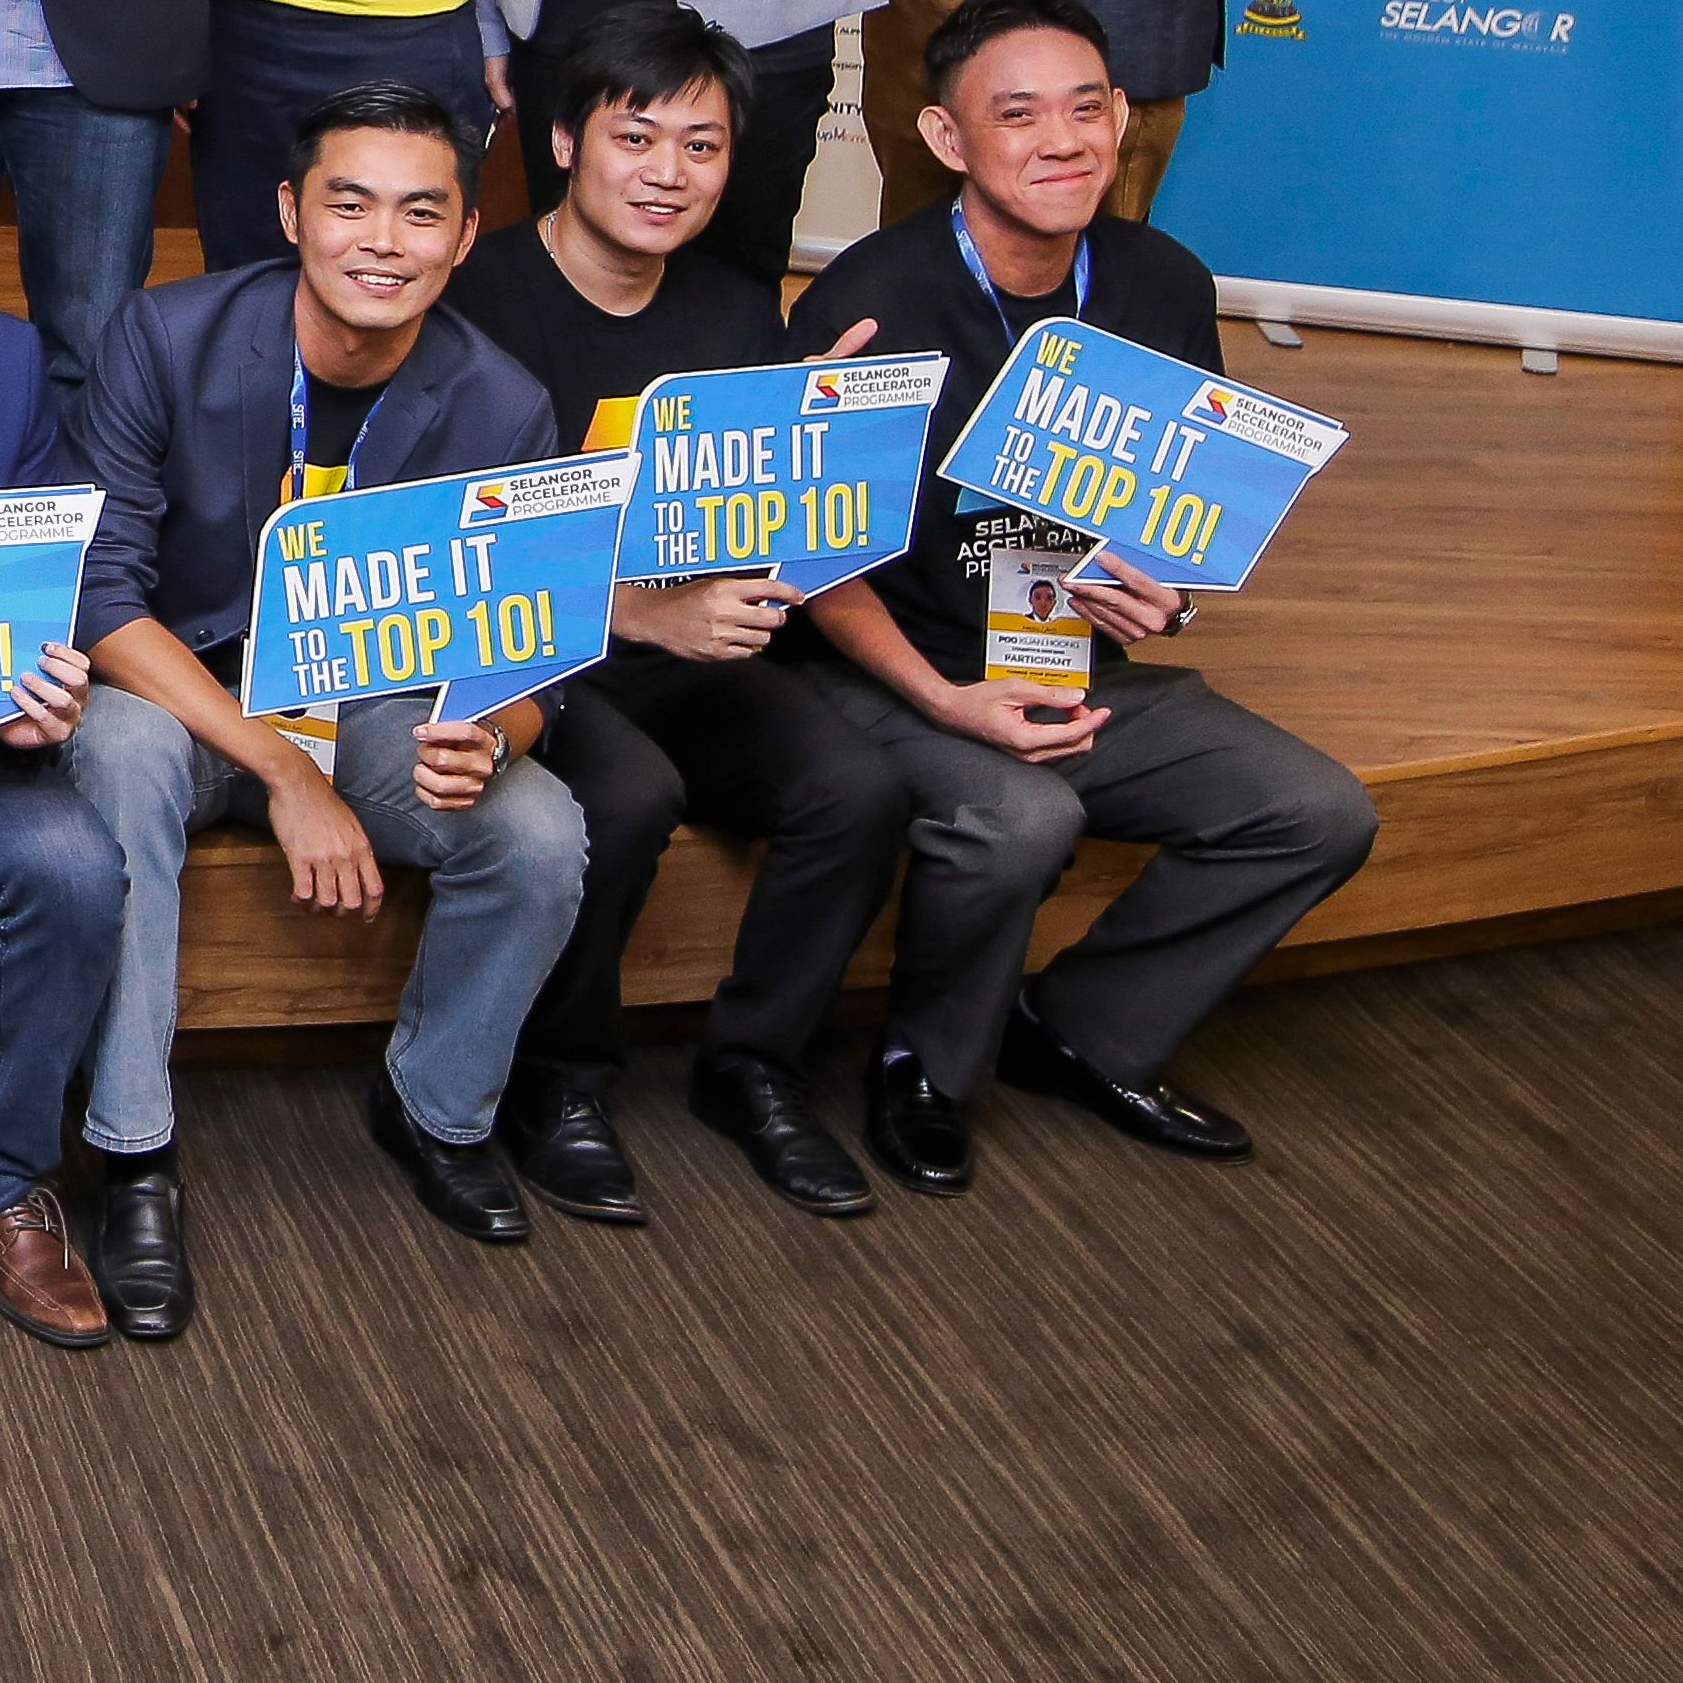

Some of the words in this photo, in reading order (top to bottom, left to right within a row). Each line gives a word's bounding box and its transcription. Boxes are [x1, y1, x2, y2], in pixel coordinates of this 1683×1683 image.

[1035, 331, 1084, 376] WE
[652, 395, 693, 433] WE
[1013, 367, 1152, 464] MADE
[1150, 419, 1207, 483] IT
[654, 426, 776, 494] MADE
[790, 421, 830, 481] IT
[1003, 425, 1036, 463] TO
[990, 455, 1042, 500] THE
[654, 501, 684, 534] TO
[695, 490, 787, 562] TOP
[799, 480, 870, 552] 10!
[1037, 441, 1138, 527] TOP
[1140, 482, 1223, 566] 10!
[277, 520, 328, 562] WE
[654, 531, 700, 567] THE
[282, 543, 435, 625] MADE
[448, 533, 498, 597] IT
[288, 628, 327, 664] TO
[337, 608, 453, 687] TOP
[466, 590, 557, 667] 10!
[1004, 653, 1072, 667] PARTICIPANT
[292, 655, 351, 697] THE
